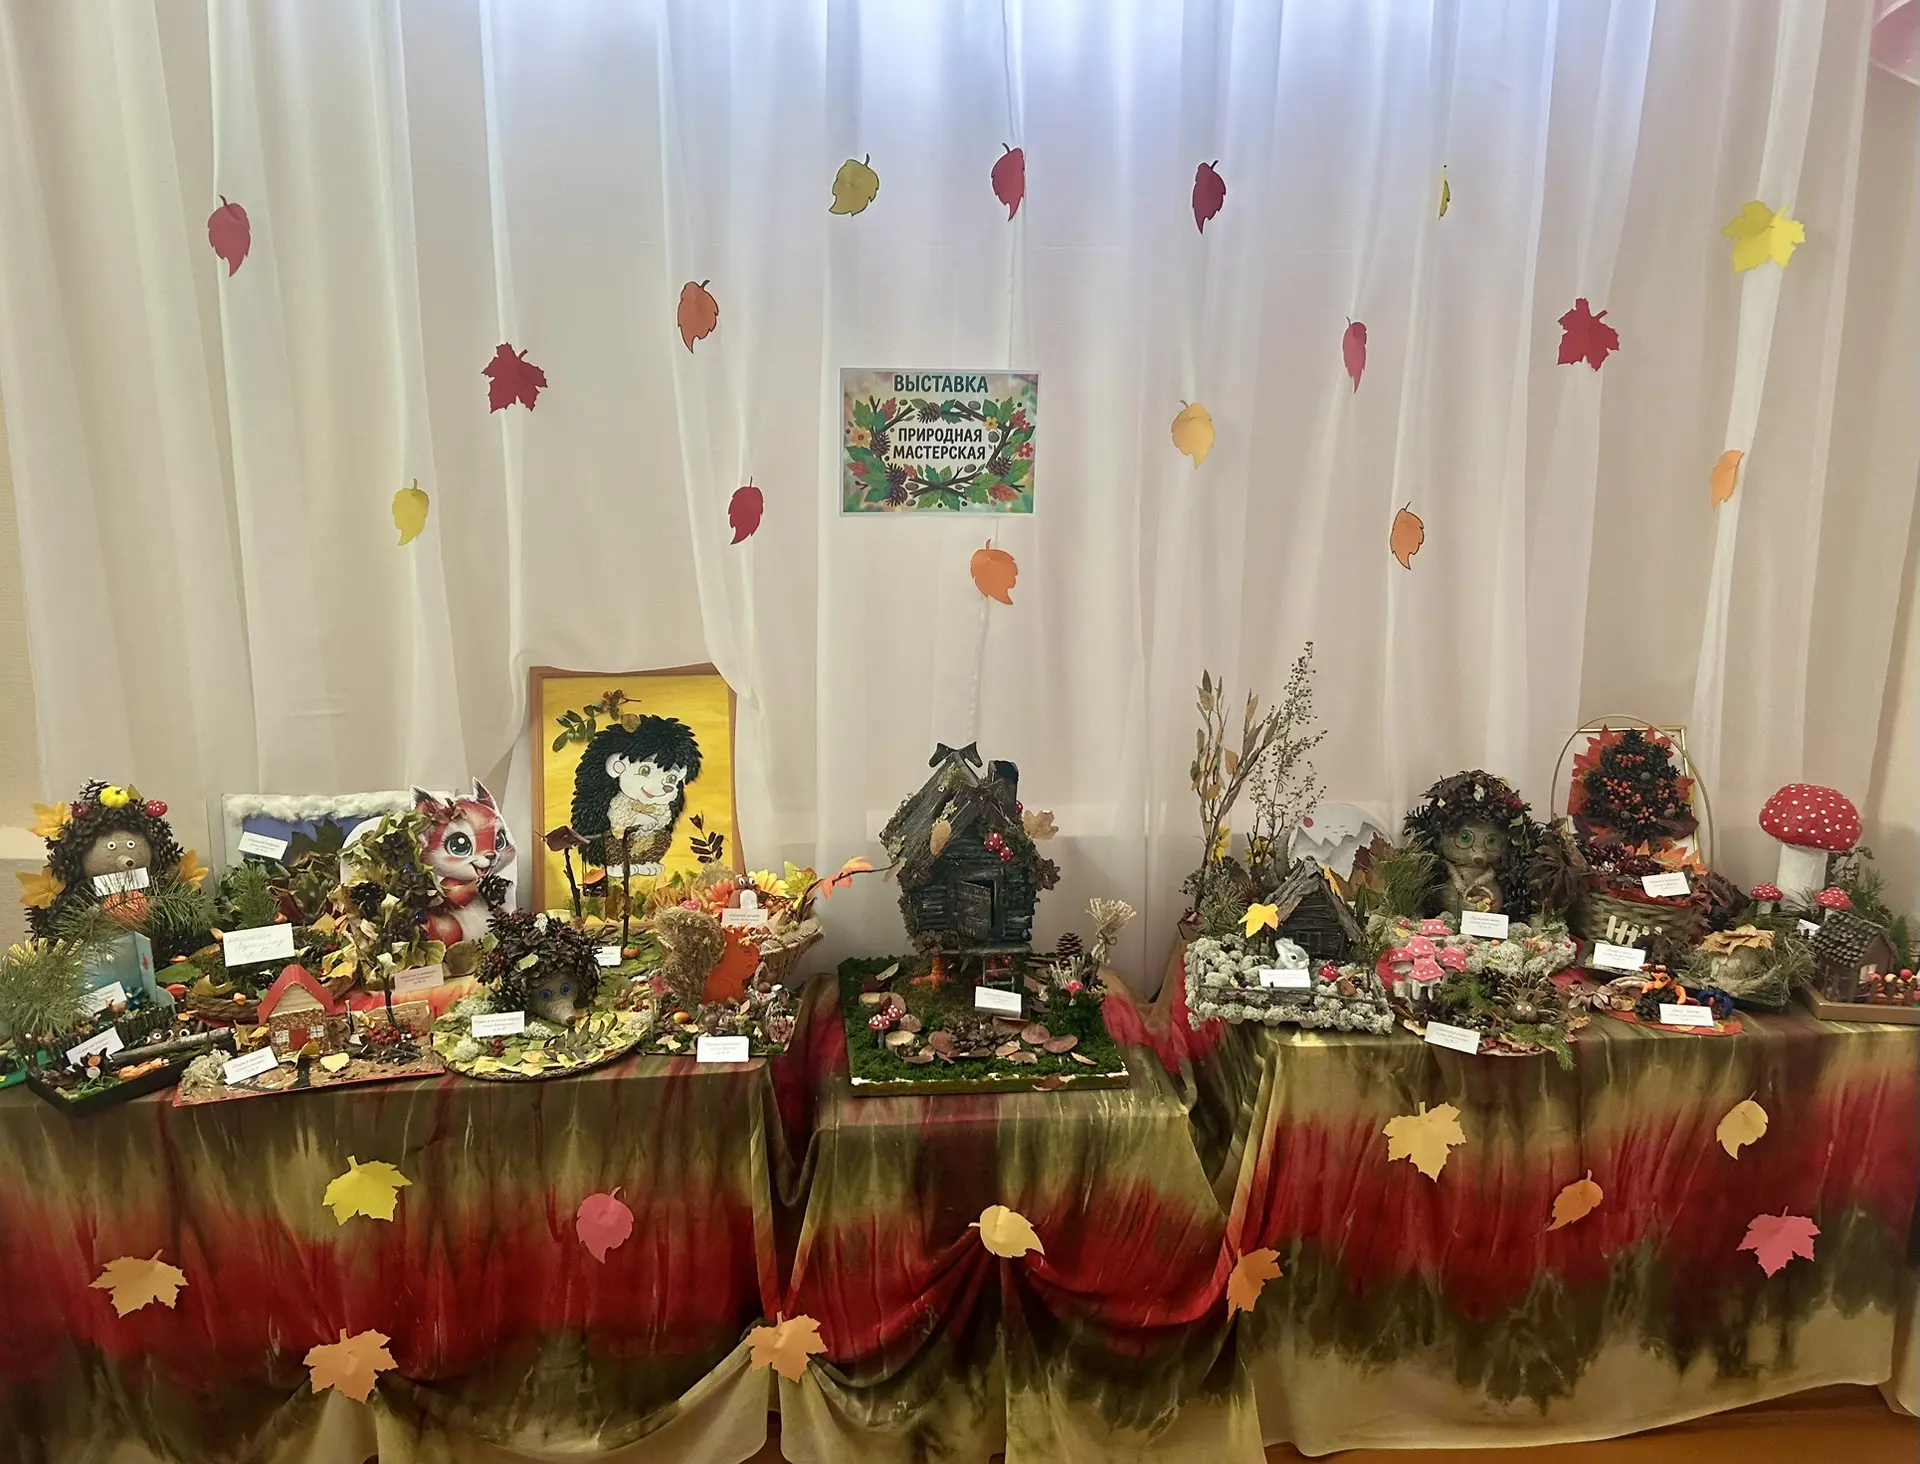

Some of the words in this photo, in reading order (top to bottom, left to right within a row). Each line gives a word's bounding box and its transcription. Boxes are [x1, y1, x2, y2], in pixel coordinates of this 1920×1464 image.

[893, 374, 988, 393] ВЫСТАВКА
[898, 428, 982, 443] ПРИРОДНАЯ
[893, 445, 985, 460] МАСТЕРСКАЯ
